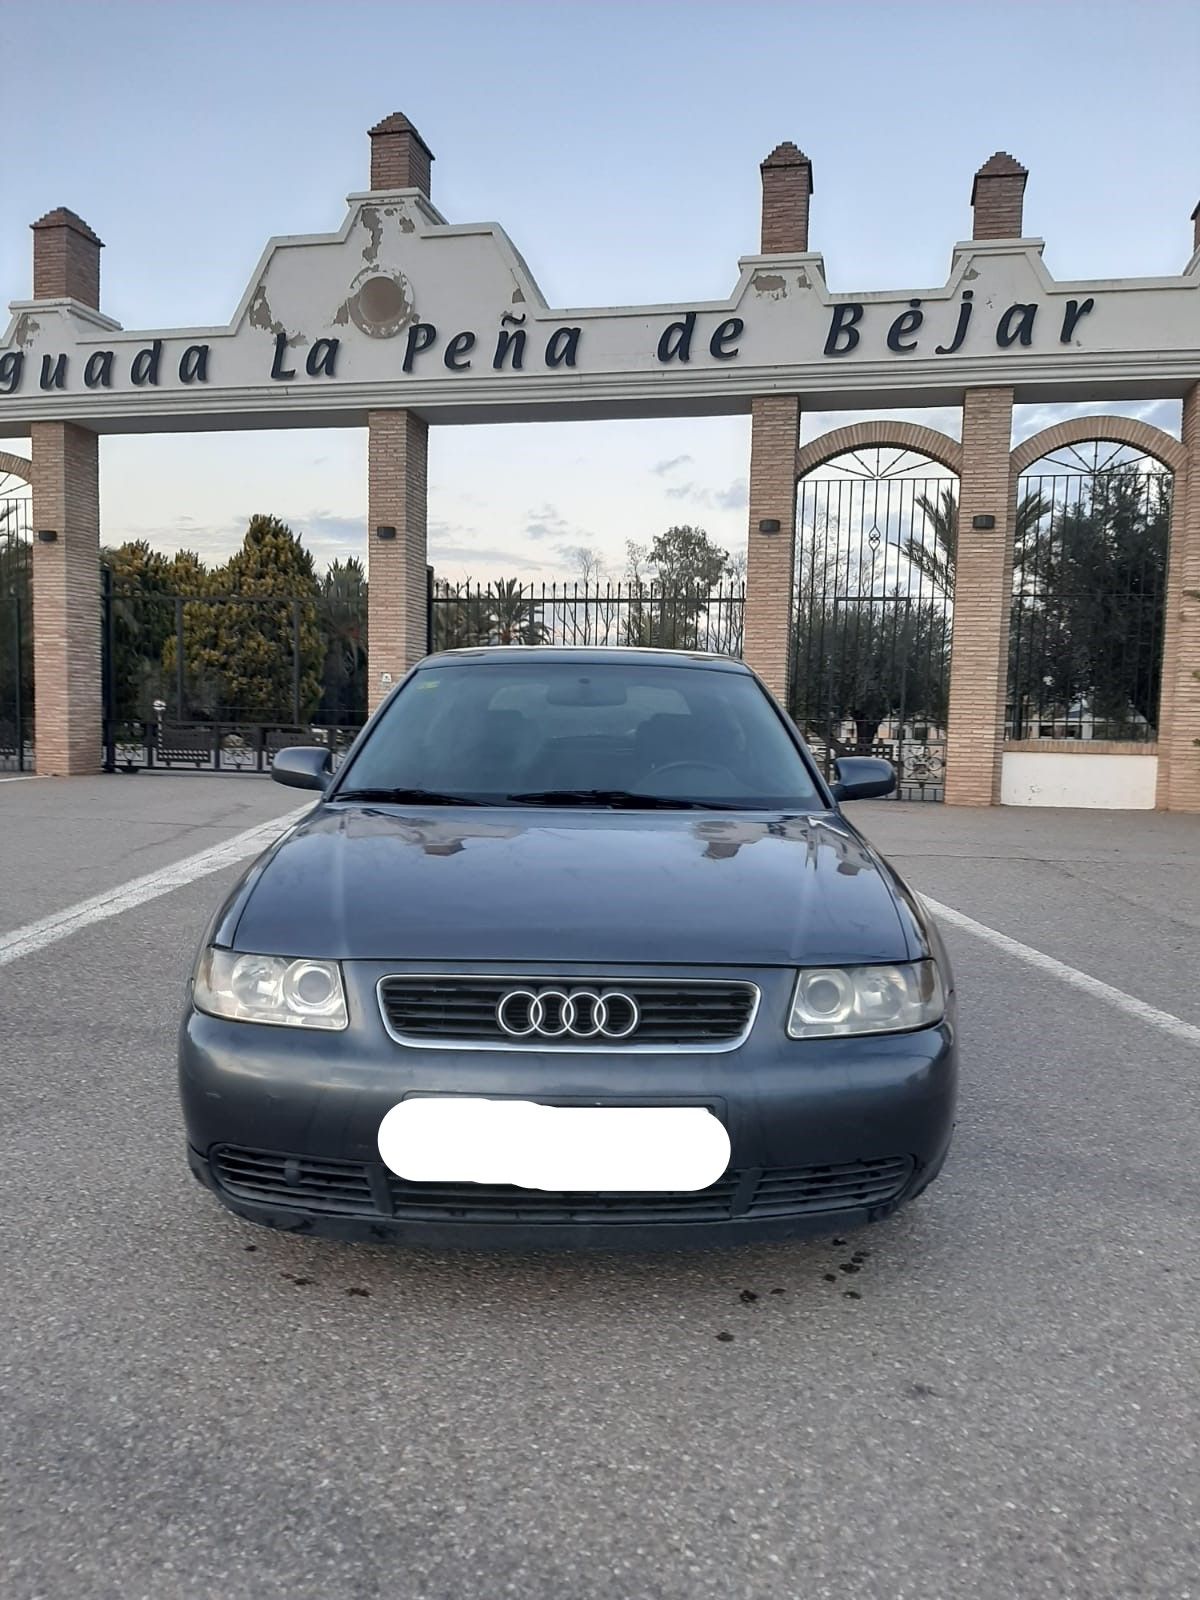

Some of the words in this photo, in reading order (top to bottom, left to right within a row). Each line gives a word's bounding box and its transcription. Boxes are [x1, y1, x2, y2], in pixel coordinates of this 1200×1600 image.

[0, 339, 209, 394] guada
[271, 332, 339, 379] La
[403, 313, 582, 373] Peña
[657, 311, 745, 362] de
